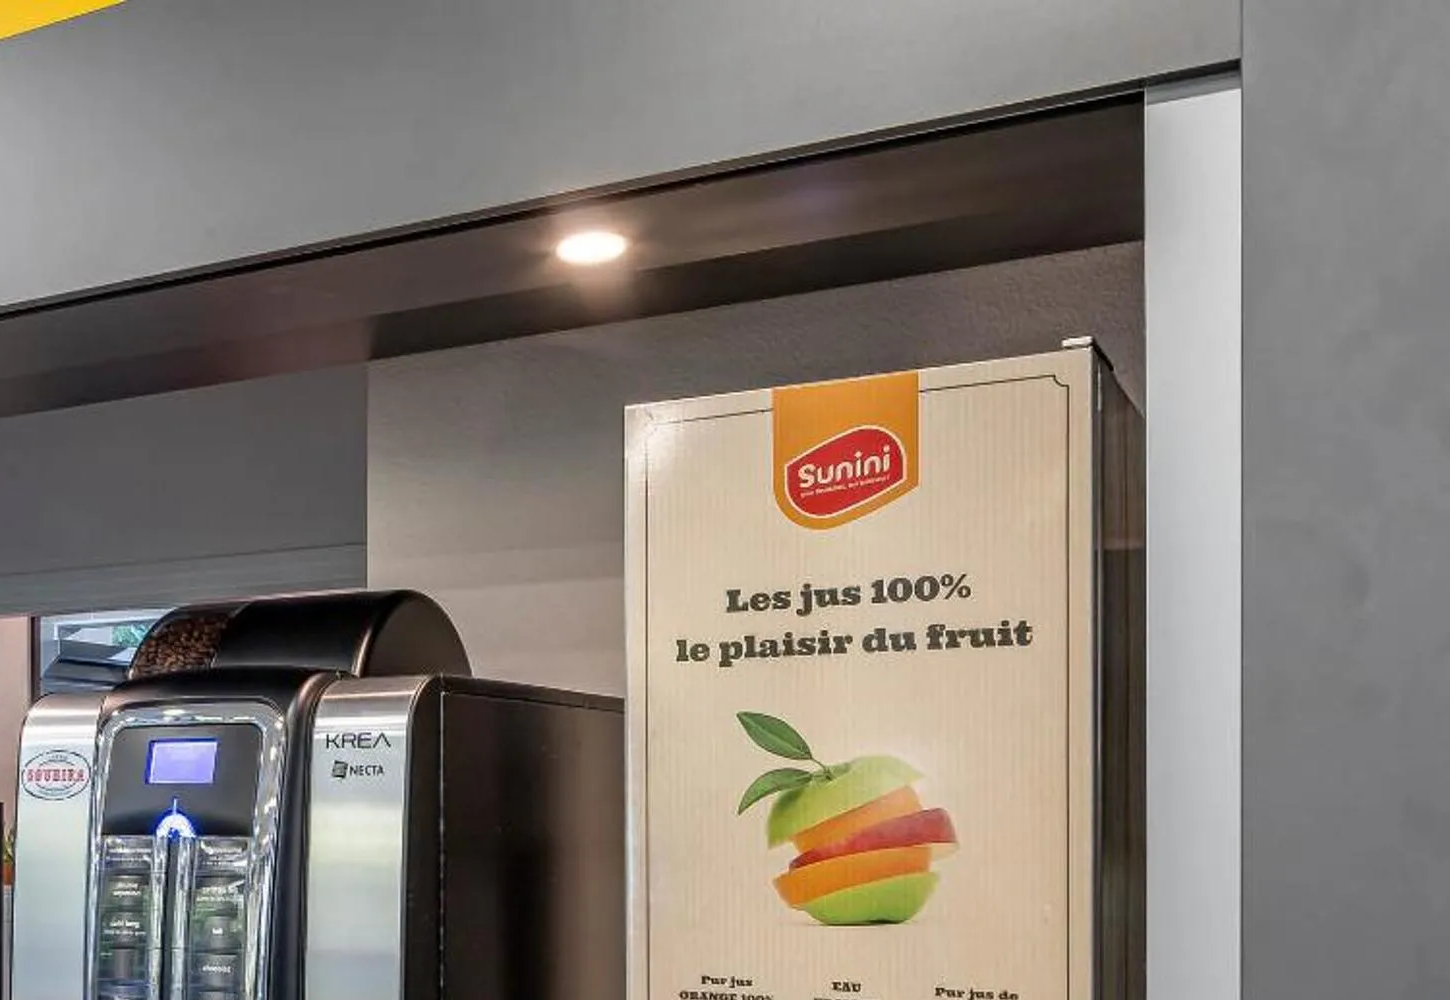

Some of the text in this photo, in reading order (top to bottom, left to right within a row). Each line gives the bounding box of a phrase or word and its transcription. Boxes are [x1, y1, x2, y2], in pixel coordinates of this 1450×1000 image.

[797, 444, 891, 489] Sunini
[725, 573, 972, 617] Les jus 100%
[675, 620, 1034, 668] le plaisir du fruit
[349, 764, 385, 776] NECTA
[701, 975, 753, 989] Pur jus
[831, 981, 862, 993] EAU
[935, 987, 966, 998] Pur
[998, 989, 1019, 1000] de
